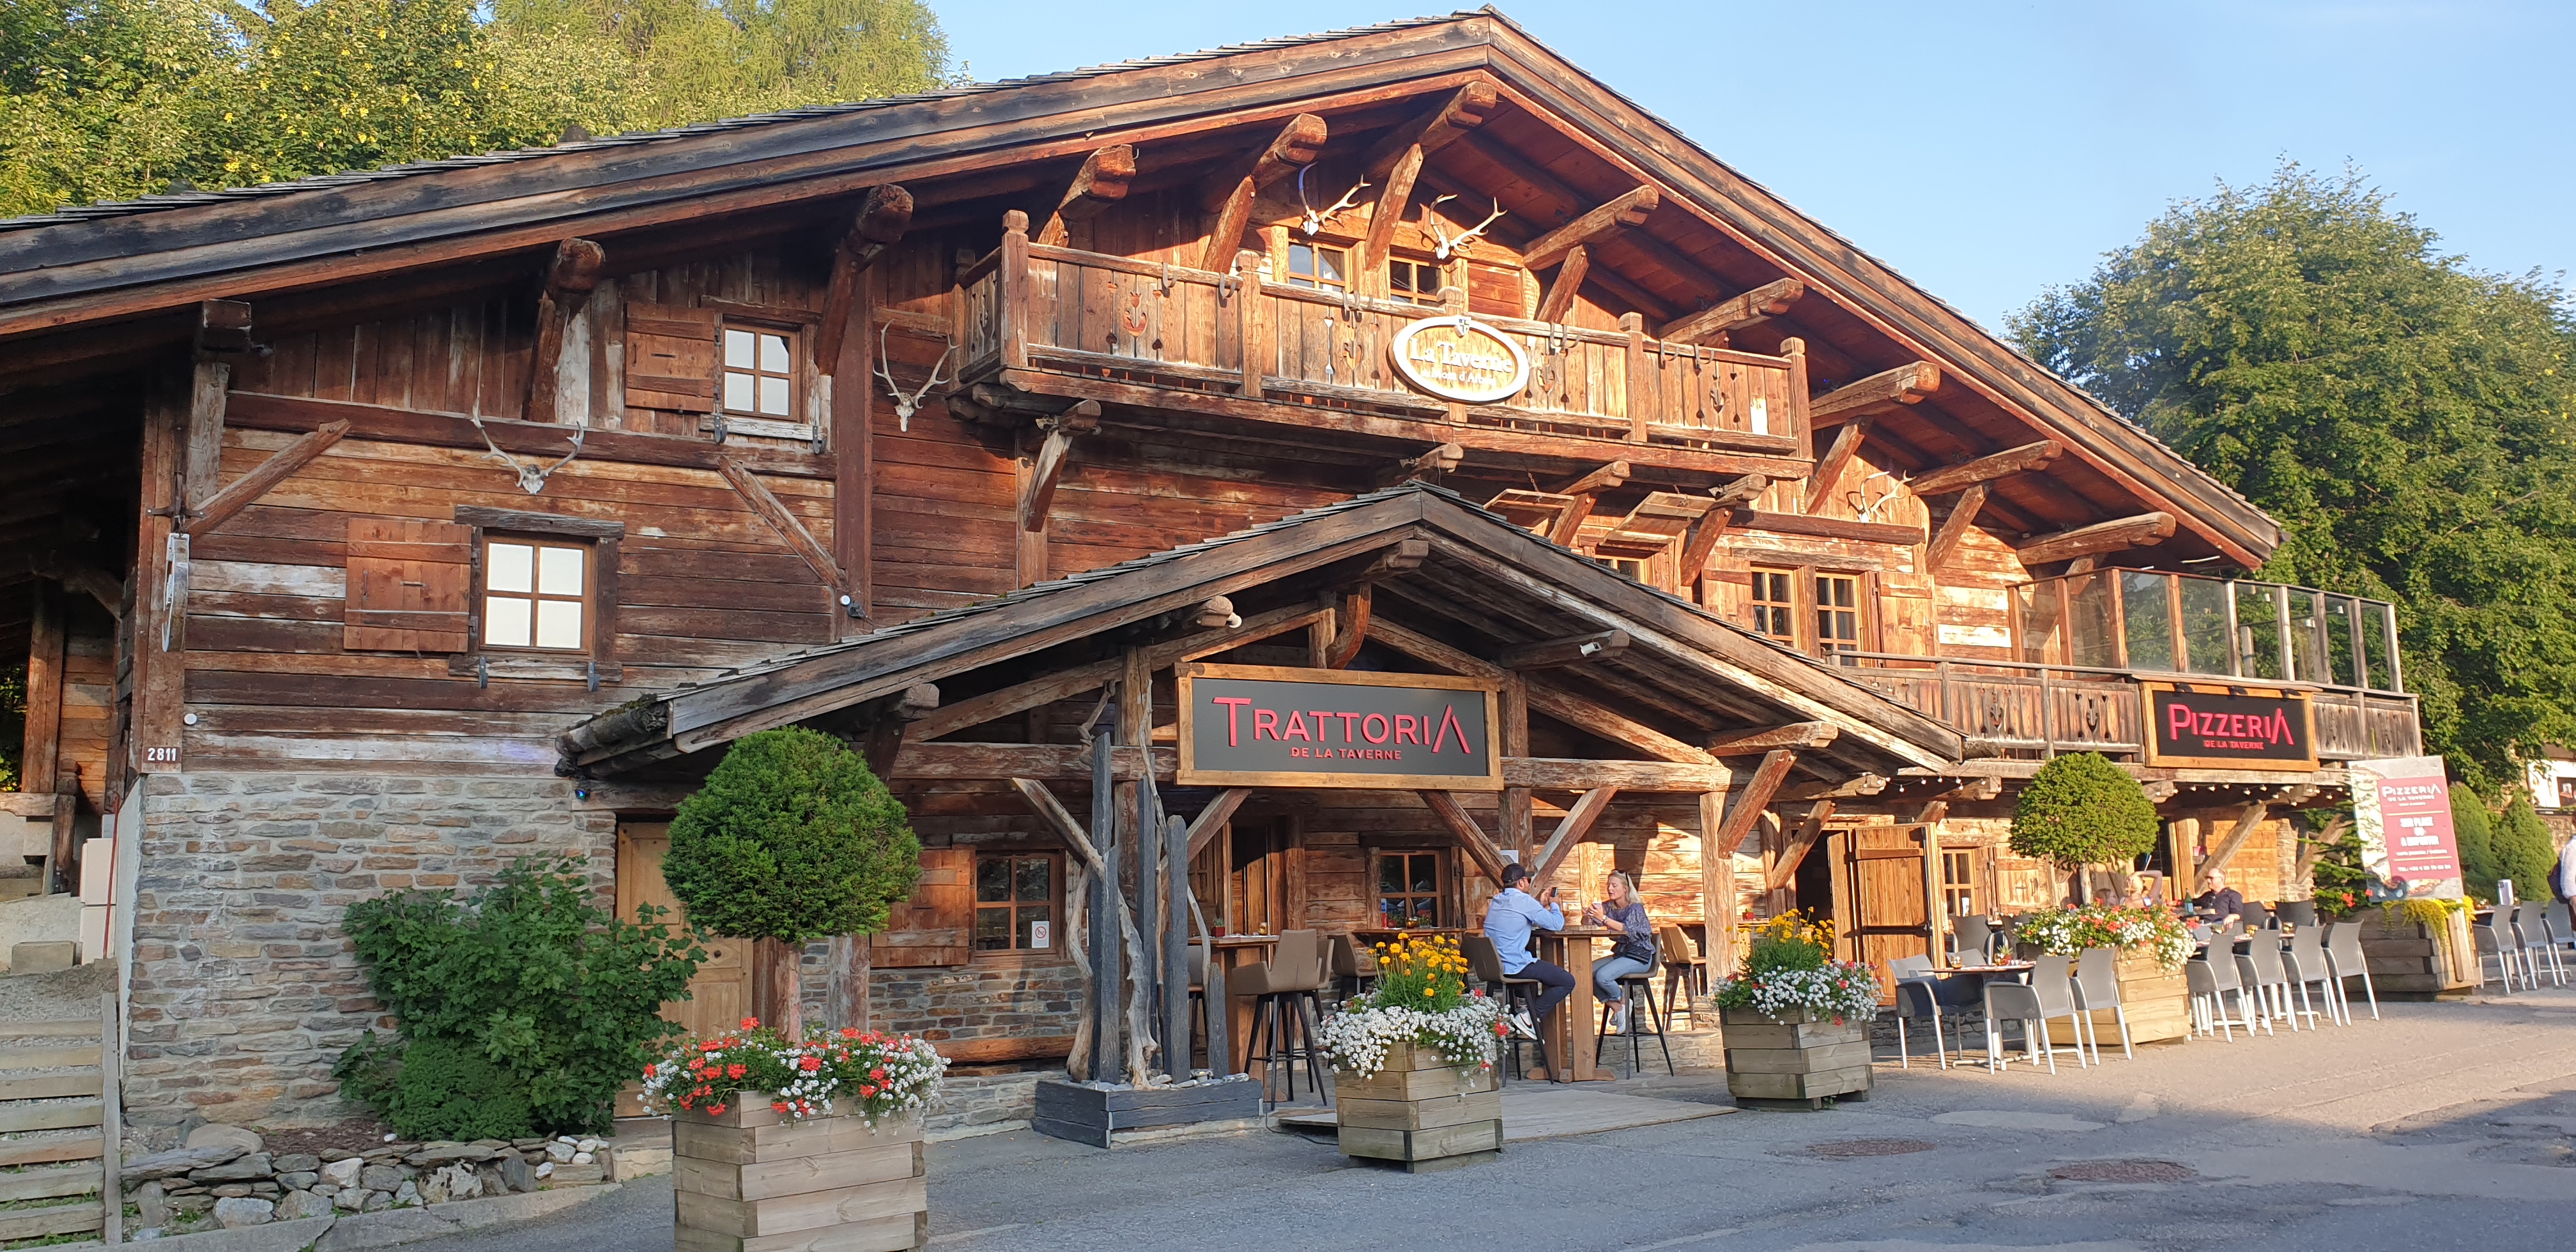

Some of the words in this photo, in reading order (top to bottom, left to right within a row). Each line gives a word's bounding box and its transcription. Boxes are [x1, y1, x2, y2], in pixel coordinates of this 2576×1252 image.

[1409, 338, 1435, 363] La
[1438, 341, 1514, 373] Taverne
[1213, 696, 1471, 754] TRATTORIA
[2168, 704, 2294, 745] PIZZERIA
[2204, 740, 2216, 749] DE
[2217, 740, 2228, 749] LA
[2230, 741, 2264, 750] TAVERNE
[148, 747, 176, 761] 2811
[1291, 747, 1310, 758] DE
[1315, 747, 1333, 759] LA
[1337, 749, 1402, 760] TAVERNE
[2381, 783, 2442, 797] PIZZERIA
